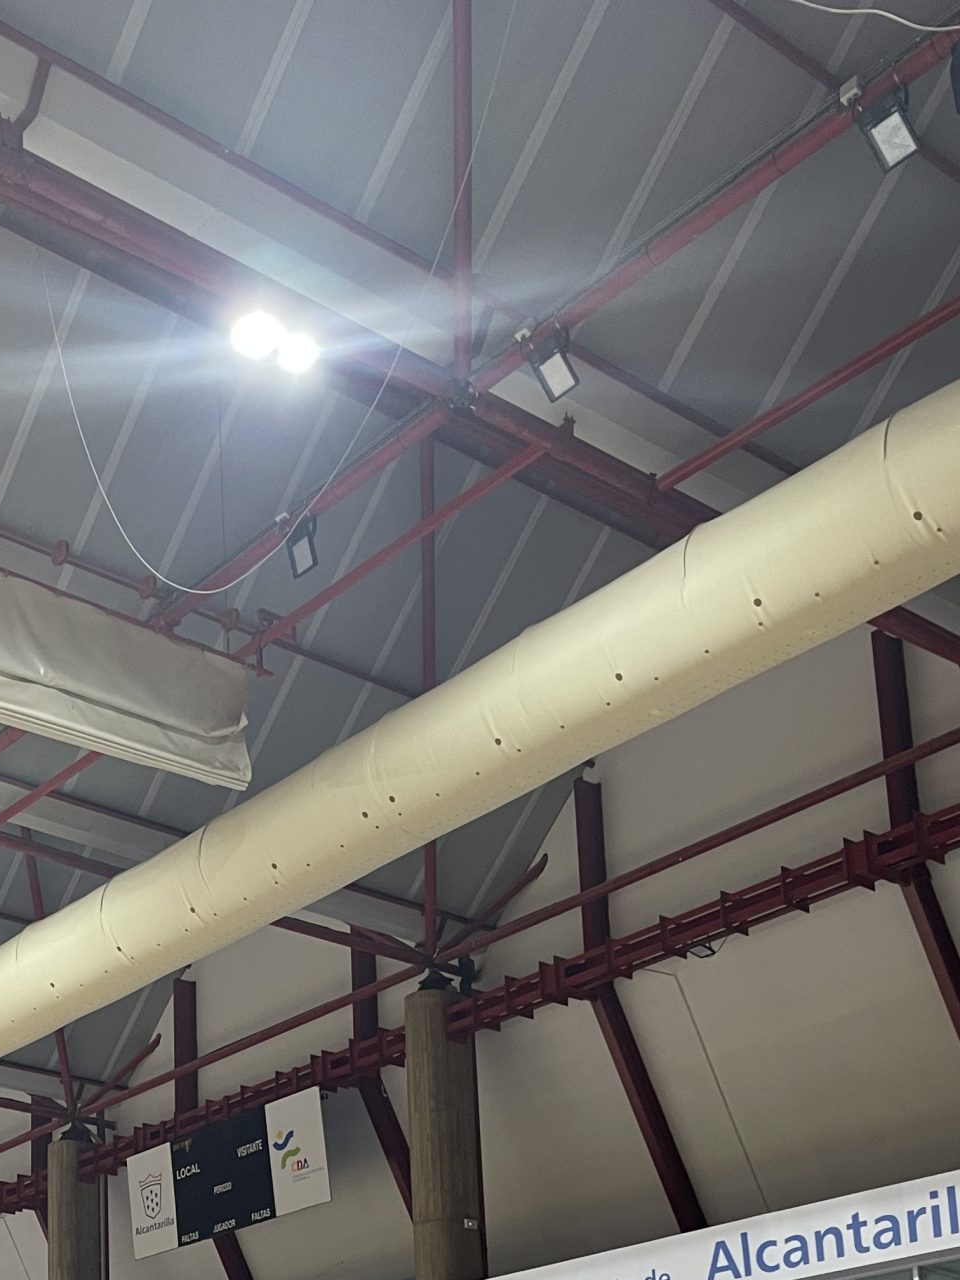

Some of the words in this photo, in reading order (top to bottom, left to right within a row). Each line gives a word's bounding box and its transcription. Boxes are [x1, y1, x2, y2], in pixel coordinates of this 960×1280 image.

[237, 1139, 263, 1158] VISITANTE
[176, 1163, 201, 1180] LOCAL
[251, 1208, 271, 1222] FALTAS
[135, 1217, 175, 1236] Alcantarilla
[213, 1219, 236, 1234] JUGADOR
[182, 1231, 200, 1244] FALTAS
